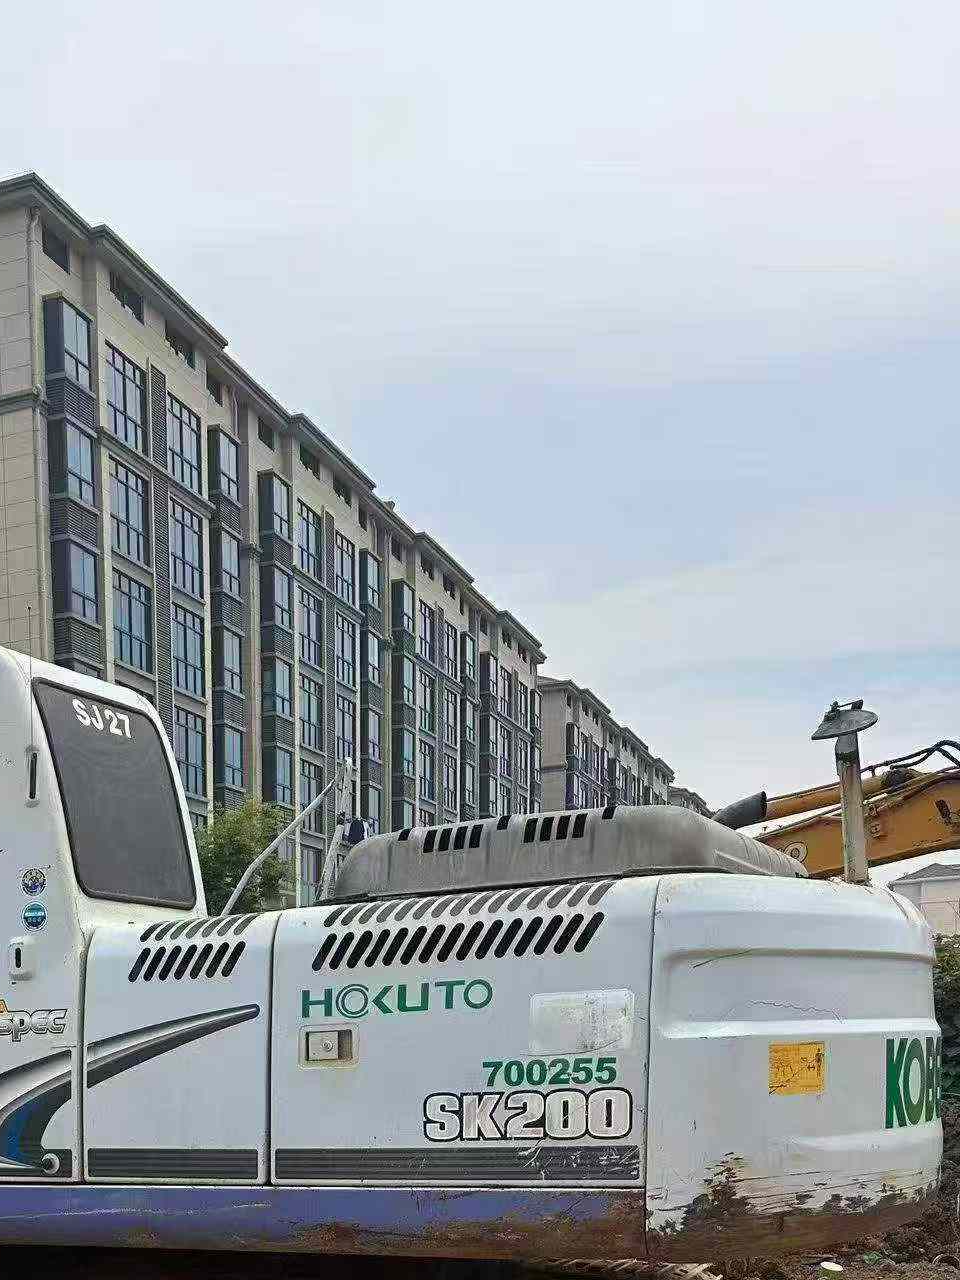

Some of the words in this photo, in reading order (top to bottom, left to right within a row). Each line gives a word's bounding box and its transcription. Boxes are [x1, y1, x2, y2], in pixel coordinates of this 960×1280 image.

[72, 698, 132, 739] SJ27
[301, 978, 493, 1019] HOKUTO
[482, 1057, 617, 1087] 700255
[423, 1087, 633, 1142] SK200
